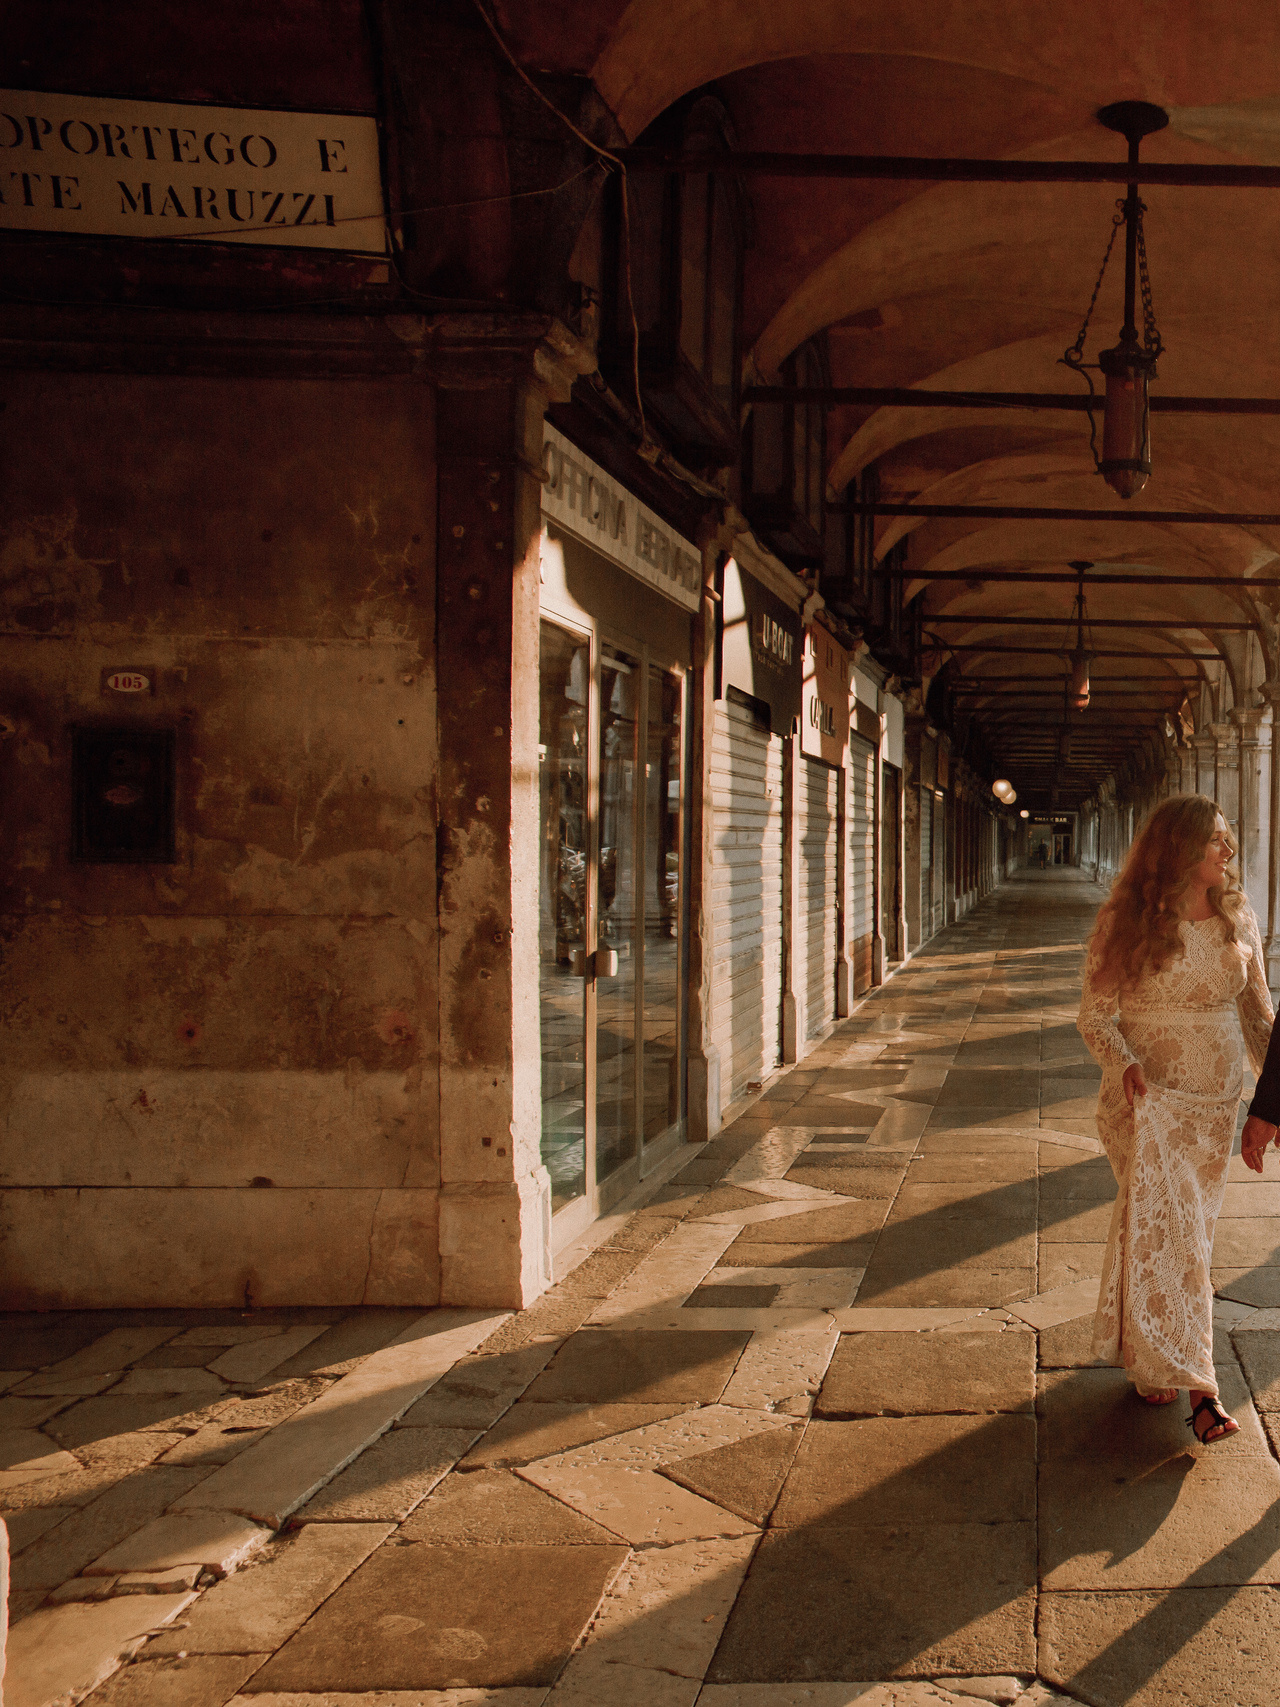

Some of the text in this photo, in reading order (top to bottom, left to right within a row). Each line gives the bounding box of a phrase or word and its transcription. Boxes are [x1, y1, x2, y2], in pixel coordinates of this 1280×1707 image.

[317, 139, 347, 172] E
[0, 172, 337, 226] TE MARUZZI
[113, 676, 143, 689] 105
